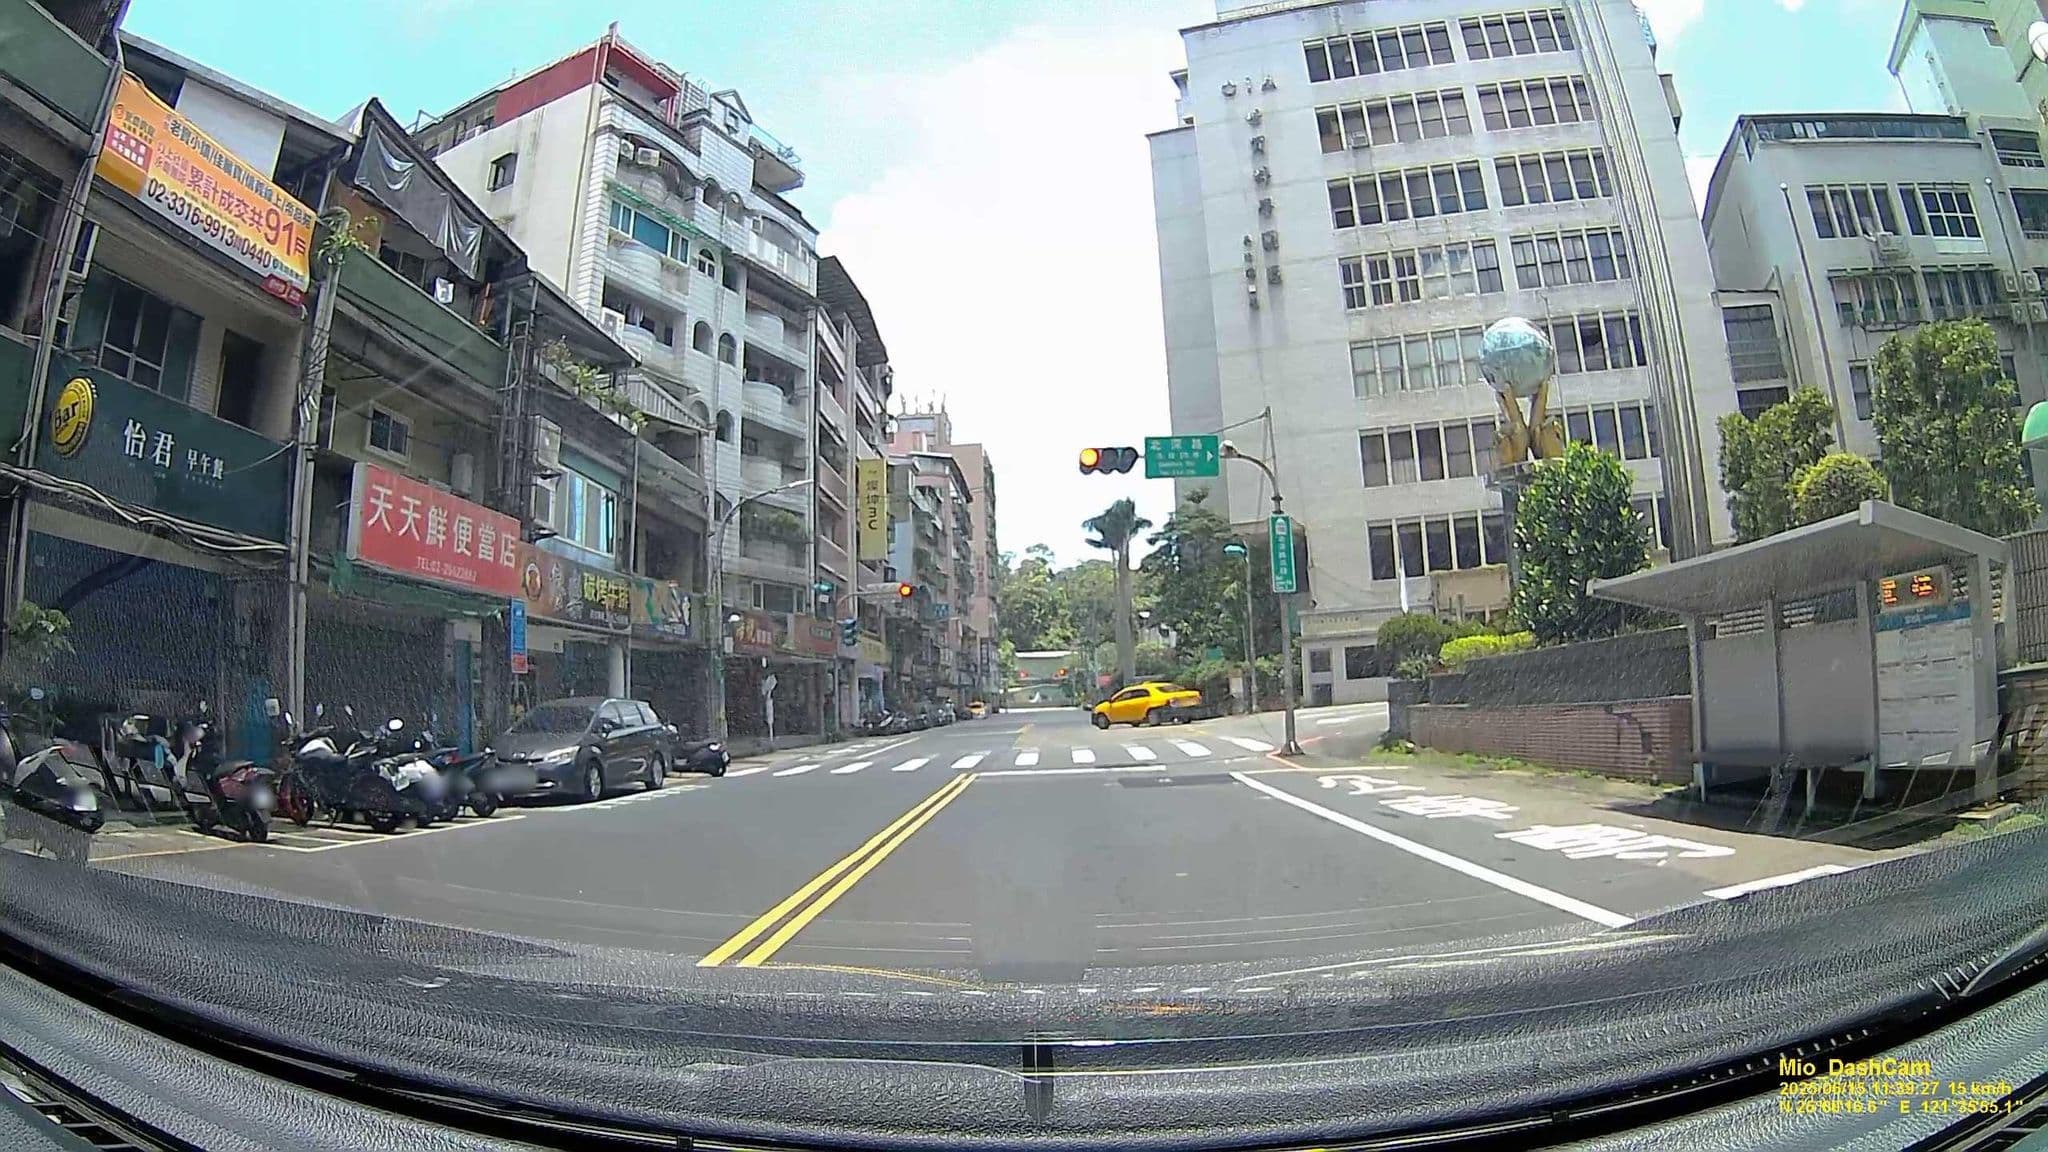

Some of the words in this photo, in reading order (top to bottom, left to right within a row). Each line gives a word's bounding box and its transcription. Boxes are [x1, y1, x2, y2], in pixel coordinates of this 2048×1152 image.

[54, 400, 80, 430] Bar
[124, 418, 175, 468] 怡君
[187, 448, 224, 481] 早午餐
[367, 484, 516, 568] 天天鮮便當店
